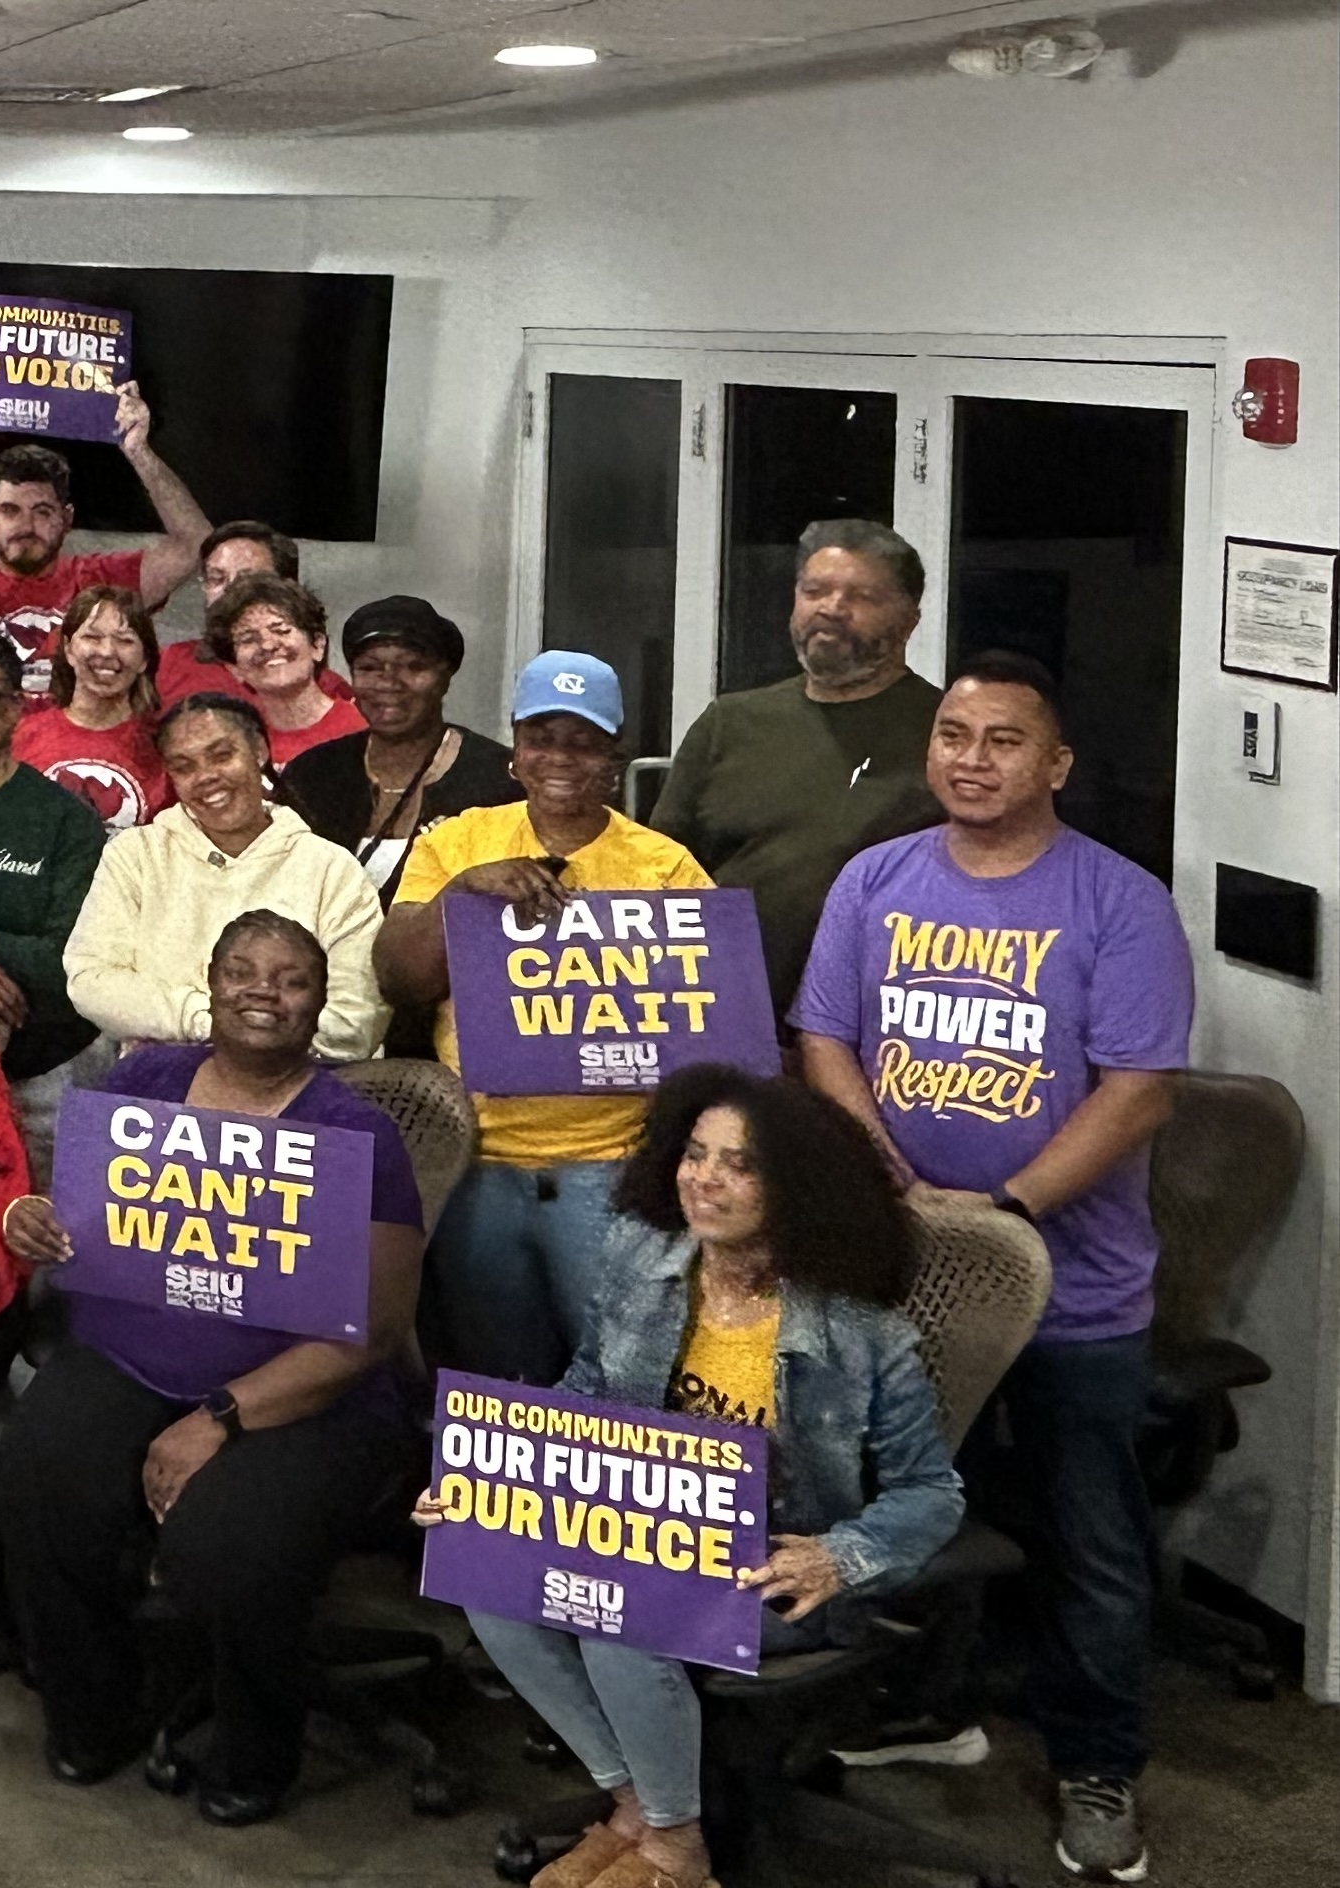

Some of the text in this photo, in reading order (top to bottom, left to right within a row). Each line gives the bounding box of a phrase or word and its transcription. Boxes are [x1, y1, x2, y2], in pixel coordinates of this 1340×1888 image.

[0, 325, 125, 364] FUTURE.
[506, 944, 710, 989] CAN'T
[884, 911, 1063, 998] MONEY
[509, 992, 716, 1036] WAIT
[879, 985, 1047, 1055] POWER
[579, 1041, 659, 1068] SEIU
[873, 1038, 1056, 1119] Respect
[109, 1105, 316, 1178] CARE
[107, 1154, 314, 1226] CAN'T
[105, 1202, 312, 1275] WAIT
[165, 1264, 243, 1299] SEIU
[446, 1390, 753, 1474] OUR COMMUNITIES.
[441, 1423, 756, 1526] OUR FUTURE.
[438, 1473, 753, 1582] OUR VOICE.
[543, 1569, 625, 1613] SEIU
